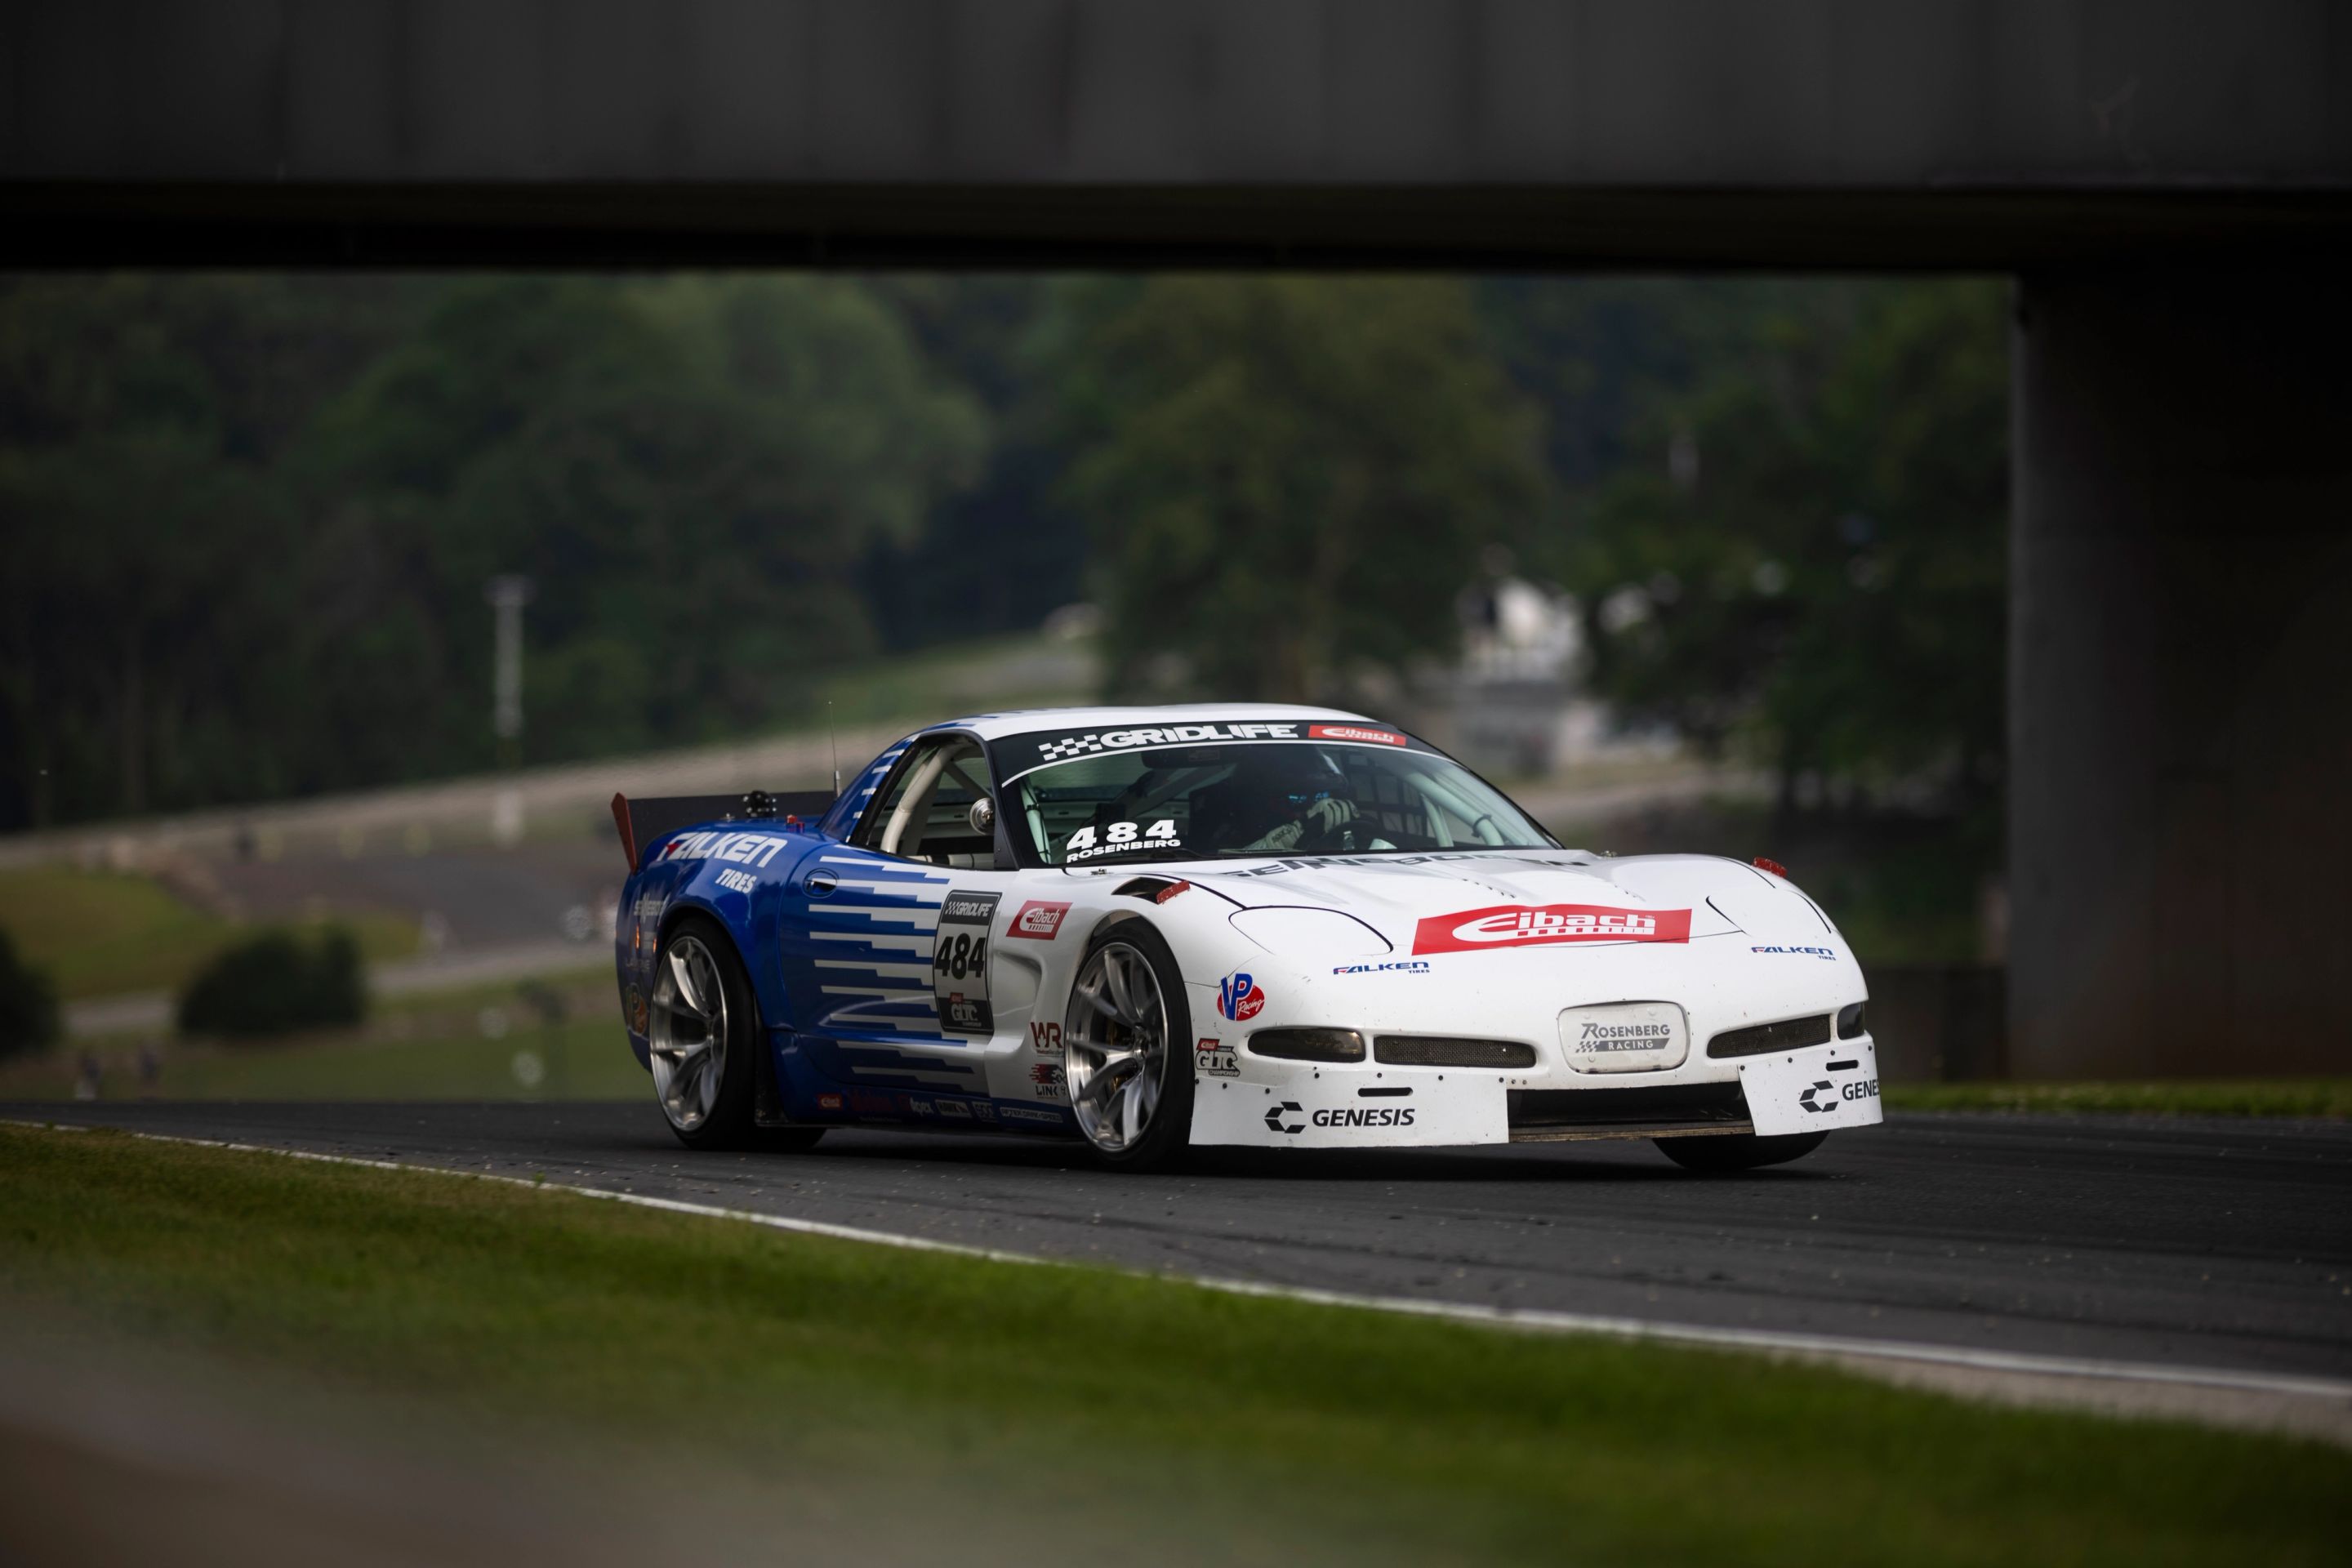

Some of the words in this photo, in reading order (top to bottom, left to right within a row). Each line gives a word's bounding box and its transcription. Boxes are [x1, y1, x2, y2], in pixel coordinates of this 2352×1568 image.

[1100, 724, 1298, 748] GRIDLIFE
[1321, 728, 1394, 743] Eibach
[657, 831, 787, 868] FALKEN
[1067, 840, 1181, 863] ROSENBERG
[715, 868, 758, 893] TIRES
[955, 902, 993, 917] GRIDLIFE
[1019, 907, 1060, 933] Eibach
[1451, 911, 1655, 942] Eibach
[935, 933, 986, 980] 484
[1751, 947, 1833, 956] FALKEN
[1333, 962, 1429, 974] FALKEN
[1220, 973, 1254, 1021] VP
[1238, 998, 1265, 1017] Racing
[1030, 1022, 1063, 1048] WR
[1581, 1023, 1670, 1039] ROSENBERG
[1608, 1040, 1654, 1050] RACING
[1196, 1050, 1238, 1070] GLTC
[1312, 1109, 1414, 1127] GENESIS
